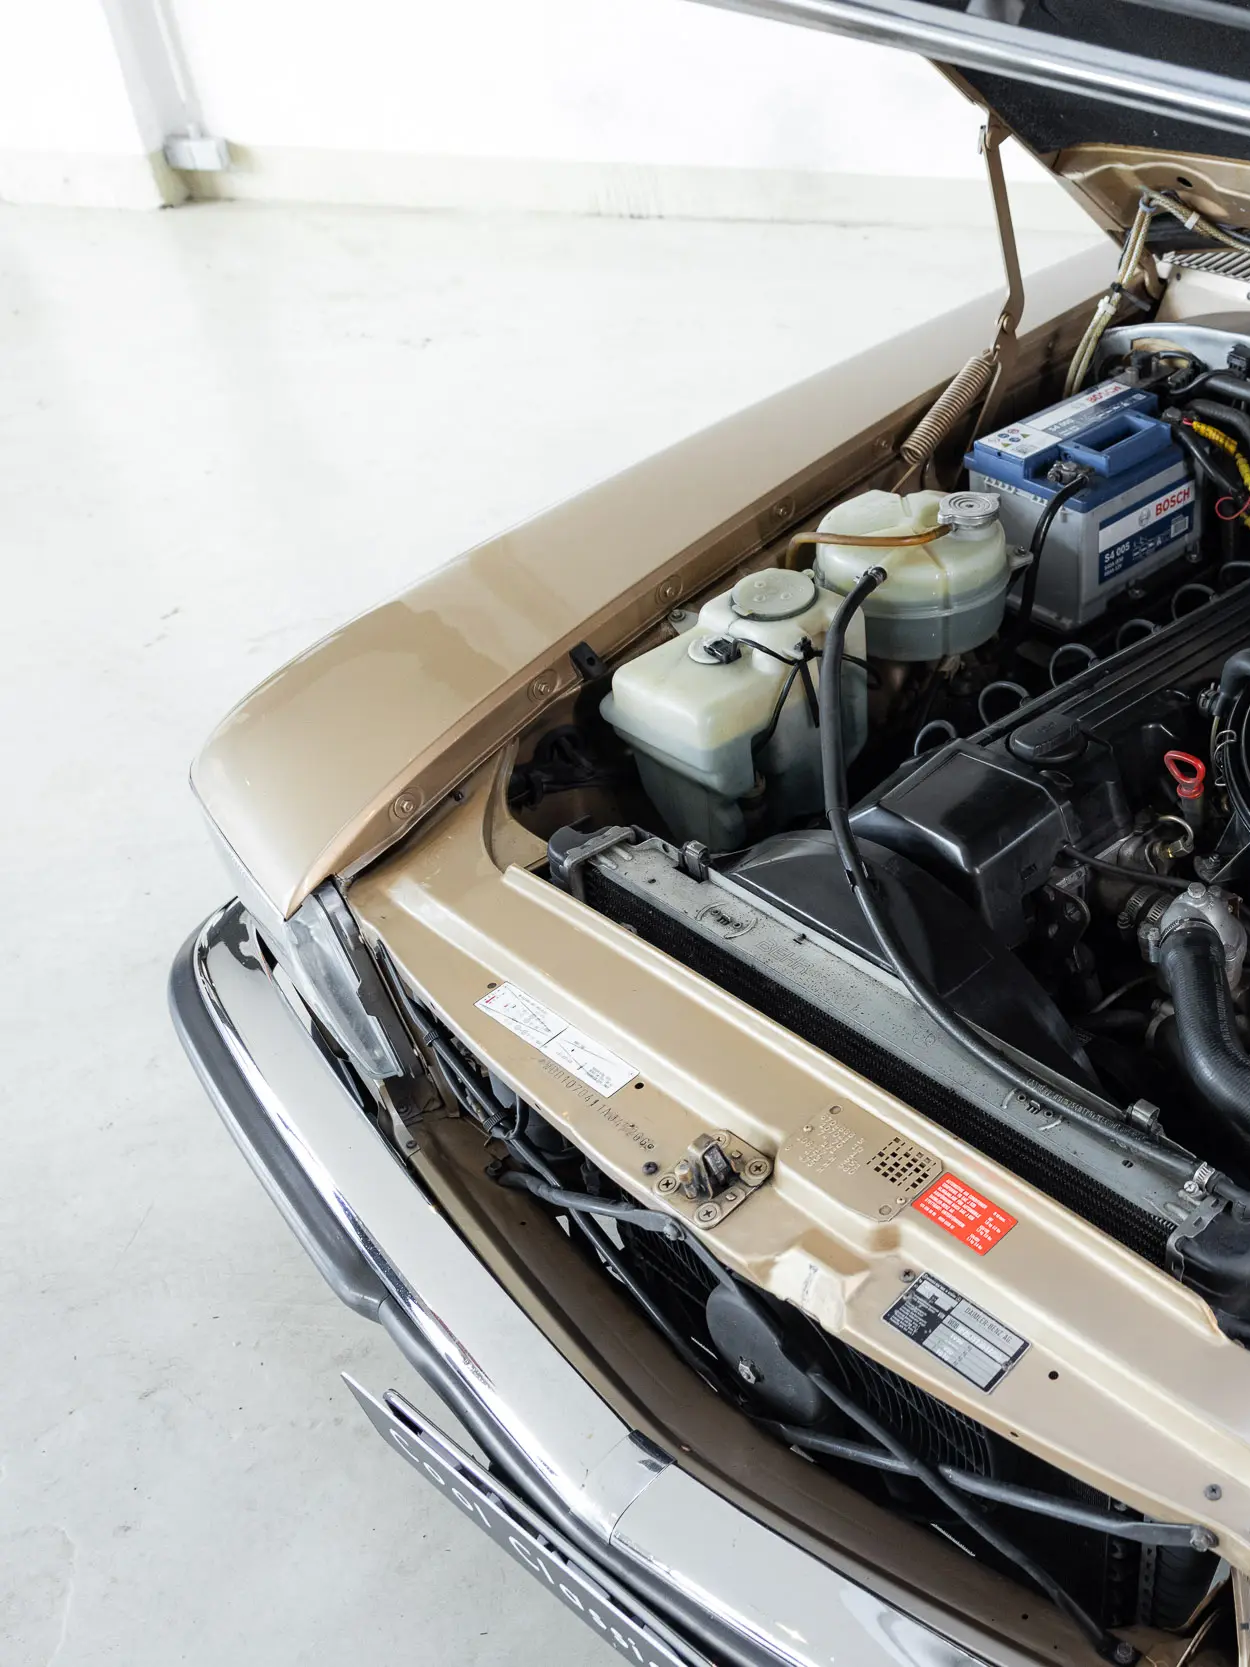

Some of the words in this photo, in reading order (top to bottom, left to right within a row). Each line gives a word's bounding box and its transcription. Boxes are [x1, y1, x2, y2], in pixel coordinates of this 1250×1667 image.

[1155, 487, 1190, 516] BOSCH
[756, 939, 815, 975] BEHR
[964, 1306, 1004, 1337] DAIMLER-BENZ
[389, 1428, 492, 1528] Cool
